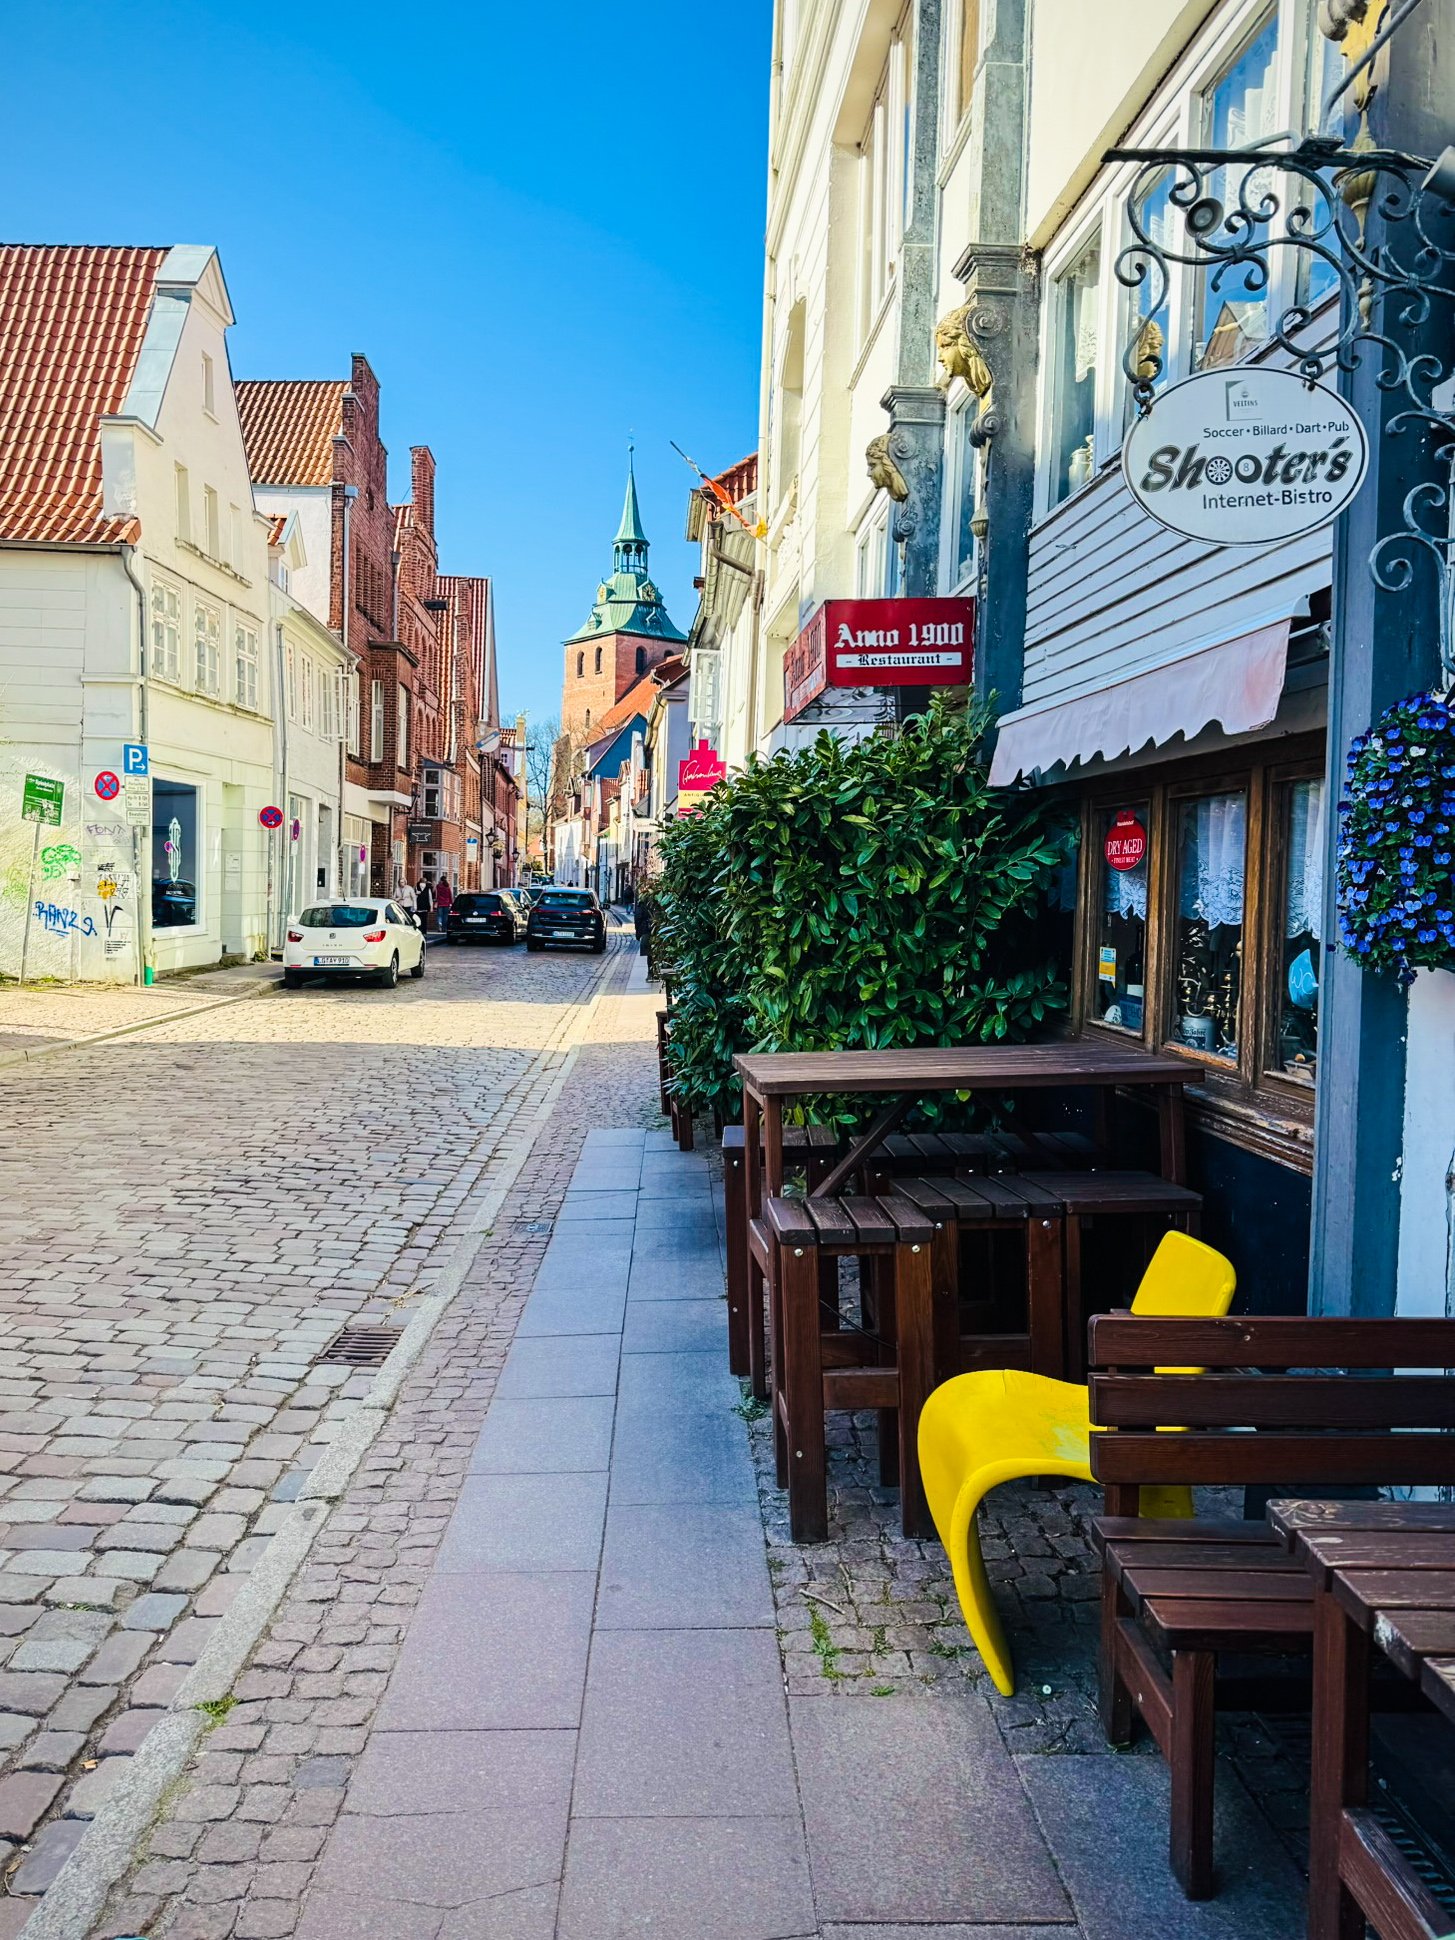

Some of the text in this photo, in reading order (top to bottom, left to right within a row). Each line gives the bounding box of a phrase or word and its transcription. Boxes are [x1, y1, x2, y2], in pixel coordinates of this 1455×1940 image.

[1232, 399, 1259, 408] VELTINS
[1203, 420, 1350, 439] Soccer Billard Dart Pub
[1202, 488, 1333, 510] Internet-Bistro
[834, 621, 965, 649] Anno 1900
[857, 653, 941, 667] Restaurant
[128, 747, 143, 771] P
[1107, 838, 1143, 856] DRY AGED
